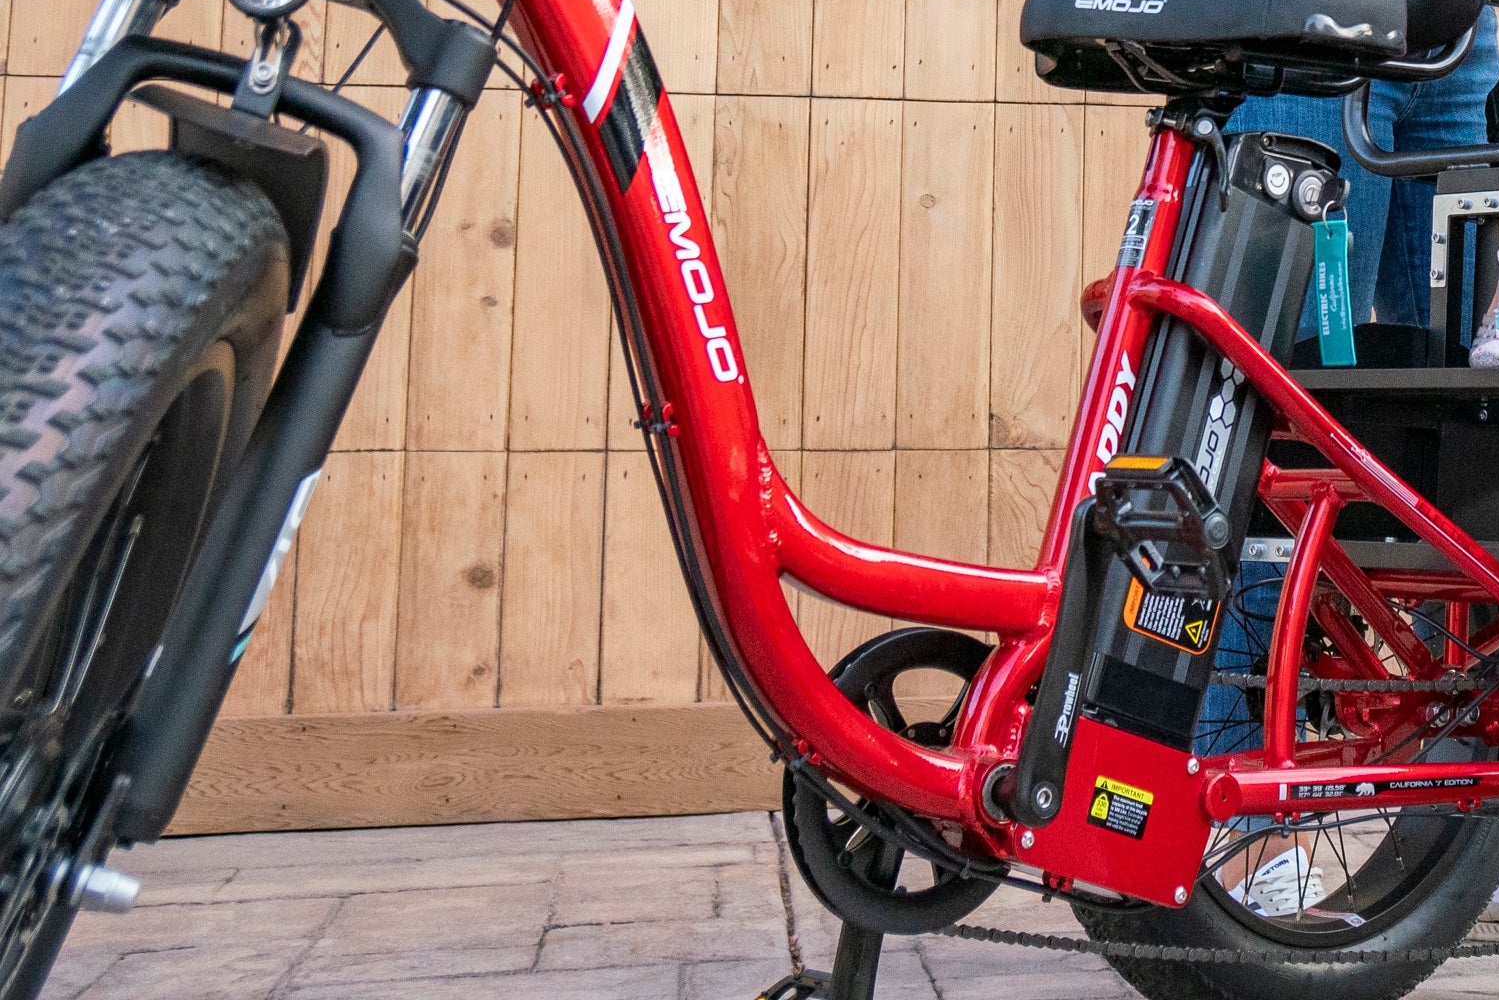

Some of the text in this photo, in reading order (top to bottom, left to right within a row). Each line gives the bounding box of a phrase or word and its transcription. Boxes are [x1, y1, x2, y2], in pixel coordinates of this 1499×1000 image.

[651, 168, 741, 383] EMOJO
[1320, 293, 1330, 335] ELECTRIC
[1054, 672, 1079, 744] Prowheel
[1111, 784, 1144, 800] IMPORTANT
[1390, 780, 1433, 788] CALIFORNIA
